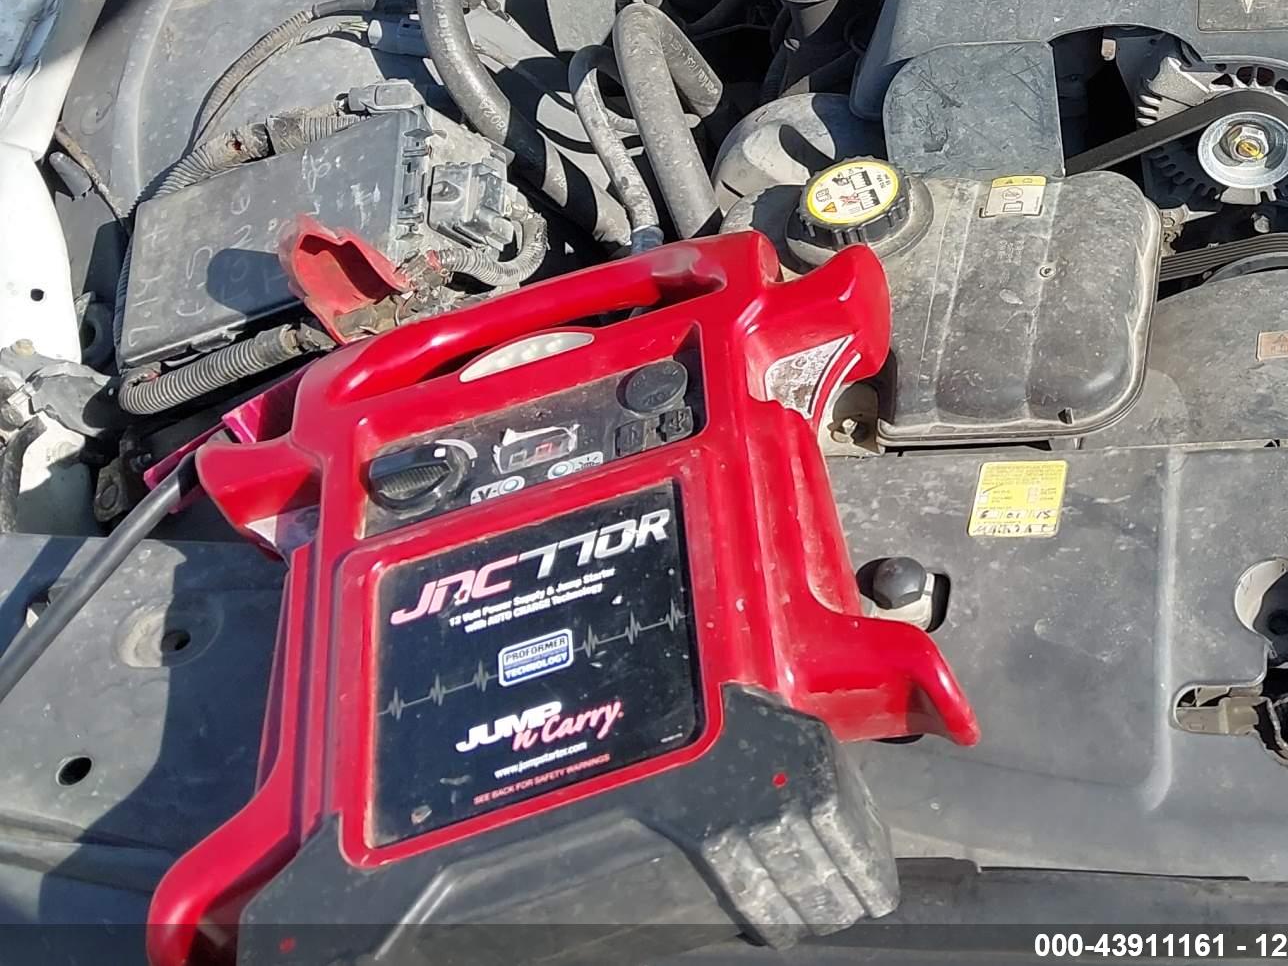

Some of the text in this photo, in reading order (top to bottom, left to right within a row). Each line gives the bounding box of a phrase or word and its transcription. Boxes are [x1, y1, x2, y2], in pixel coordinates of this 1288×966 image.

[482, 600, 512, 617] Power
[513, 590, 546, 607] Supply
[555, 578, 582, 594] Jump
[583, 566, 616, 585] Starter
[487, 610, 512, 627] AUTO
[551, 582, 603, 607] Technology
[504, 637, 566, 663] PROFORMER
[505, 652, 568, 679] TECHNOLOGY
[455, 700, 562, 753] JUMP
[473, 753, 611, 806] SEE BACK FOR SAFETY WARNINGS
